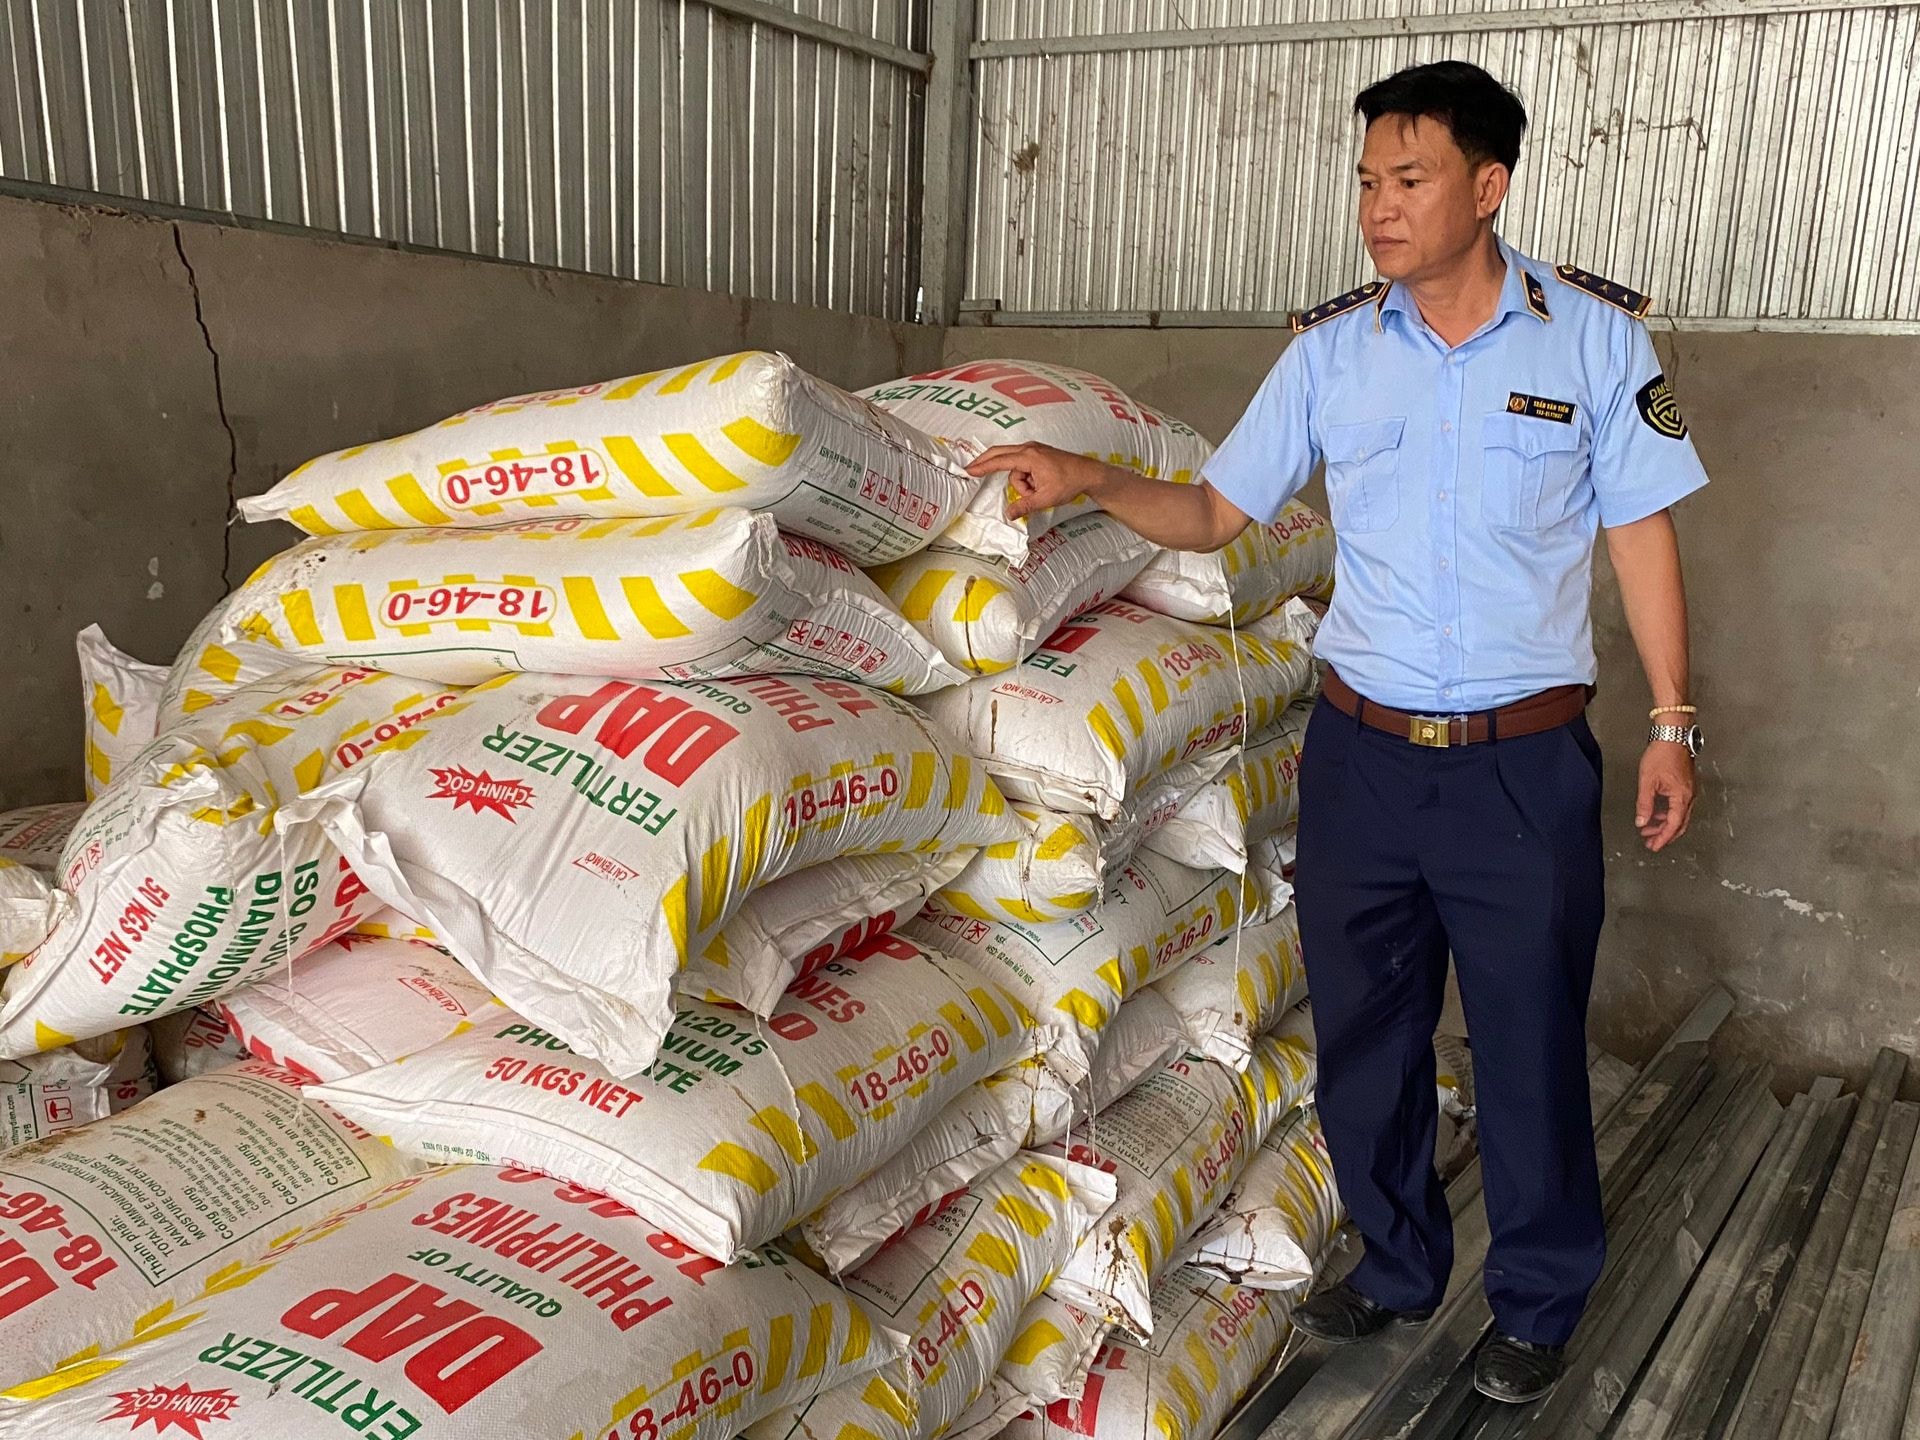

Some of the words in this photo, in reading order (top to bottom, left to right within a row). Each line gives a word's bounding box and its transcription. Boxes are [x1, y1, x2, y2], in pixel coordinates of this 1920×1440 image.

[446, 454, 600, 504] 18-46-0
[387, 586, 548, 621] 18-46-0
[675, 679, 753, 715] QUALIT
[536, 680, 741, 788] DAP
[438, 772, 475, 796] GỐC
[478, 781, 528, 804] CHÍNH
[482, 724, 678, 836] FERTILIZER
[784, 768, 899, 828] 18-46-0
[137, 877, 170, 908] 50
[289, 858, 320, 917] ISO
[88, 931, 133, 985] NET
[118, 886, 235, 1016] PHOSPHATE
[825, 963, 858, 977] OF
[674, 1009, 770, 1057] 1:2015
[485, 1056, 528, 1081] 50
[520, 1062, 587, 1096] KGS
[579, 1078, 644, 1119] NET
[850, 1028, 950, 1110] 18-46-0
[284, 1127, 298, 1141] an
[292, 1139, 314, 1161] báo
[1197, 1110, 1244, 1190] 18-46-0
[90, 1159, 149, 1204] PHOSPHORUS
[268, 1178, 298, 1207] Cách
[308, 1156, 340, 1189] Cảnh
[95, 1180, 149, 1230] AMMONIACAL
[143, 1199, 191, 1249] AVAILABLE
[161, 1195, 206, 1241] MOISTURE
[204, 1209, 235, 1241] Công
[0, 1190, 119, 1292] 18-46-
[143, 1226, 174, 1257] TOTAL
[407, 1248, 453, 1267] OF
[411, 1192, 674, 1332] PHILIPPINES
[445, 1261, 563, 1318] QUALITY
[279, 1272, 545, 1415] DAP
[198, 1332, 423, 1440] ERTILIZER
